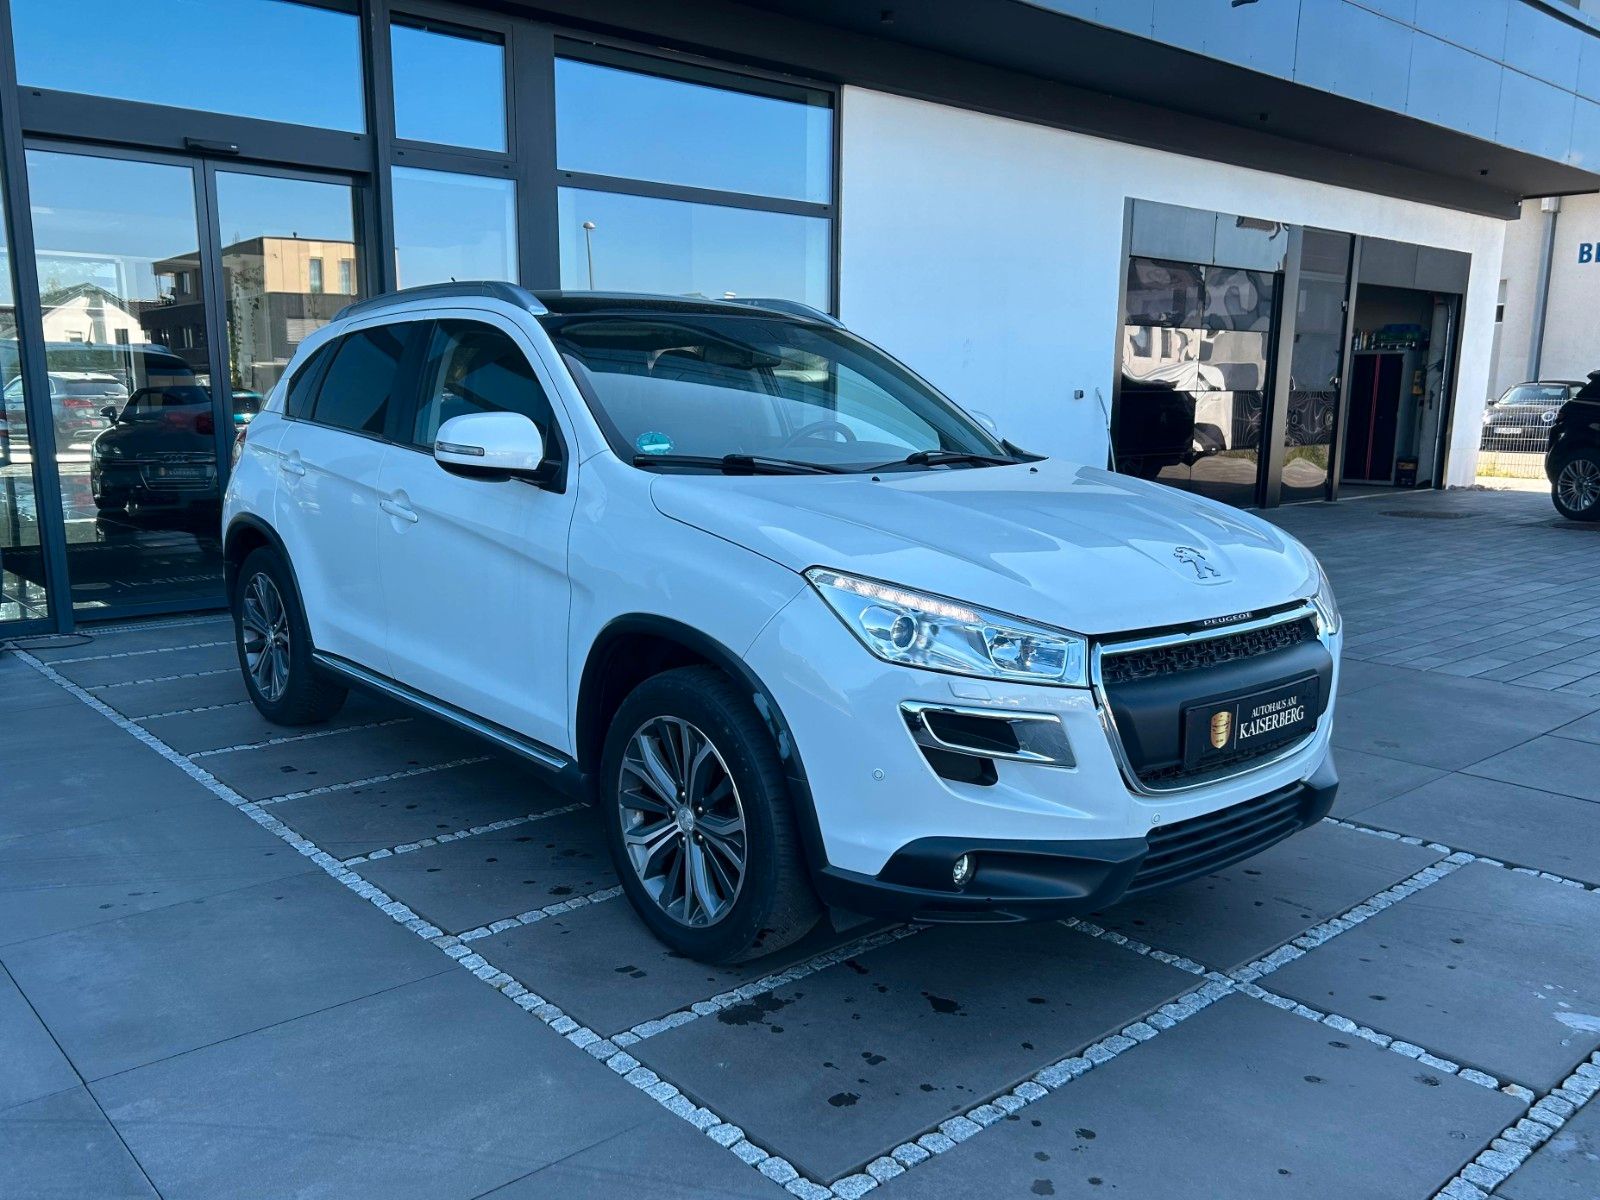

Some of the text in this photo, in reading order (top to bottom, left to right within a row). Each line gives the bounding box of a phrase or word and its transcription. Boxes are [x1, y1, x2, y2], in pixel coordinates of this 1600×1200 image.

[1203, 612, 1252, 626] PEUGEOT
[1251, 696, 1297, 718] AUTOHAUS AM
[1239, 705, 1305, 739] KAISERBERG
